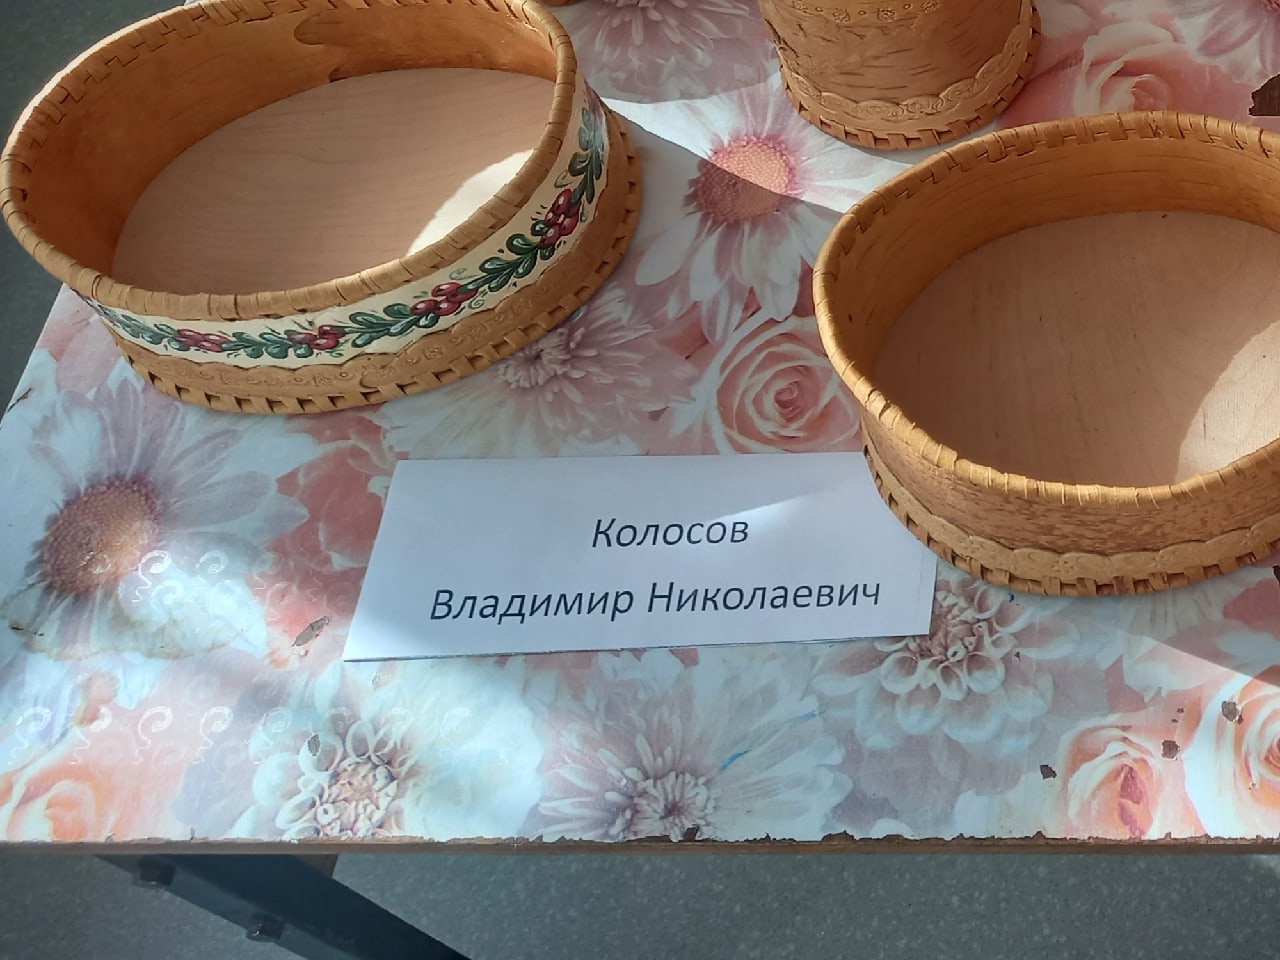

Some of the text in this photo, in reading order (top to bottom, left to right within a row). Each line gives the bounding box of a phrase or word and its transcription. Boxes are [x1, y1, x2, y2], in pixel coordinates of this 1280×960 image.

[592, 518, 749, 547] Колосов
[430, 582, 881, 622] Владимир Николаевич
